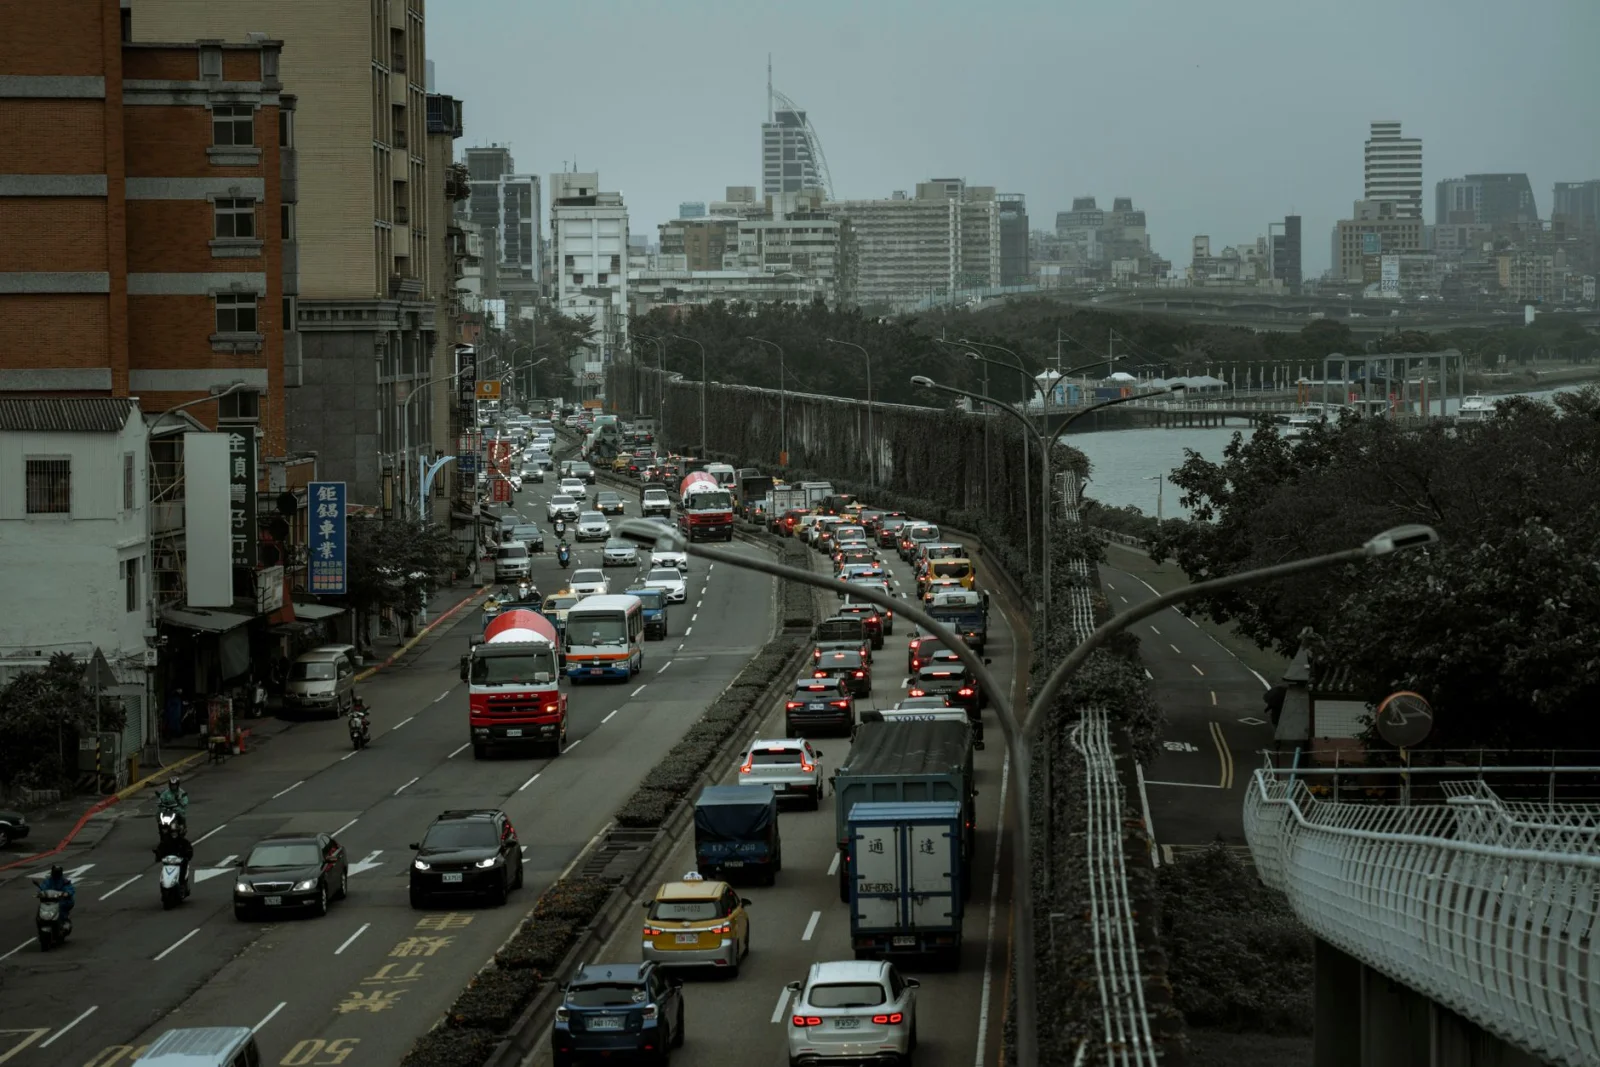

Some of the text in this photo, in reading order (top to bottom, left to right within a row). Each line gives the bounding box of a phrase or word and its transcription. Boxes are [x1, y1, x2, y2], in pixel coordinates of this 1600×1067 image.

[895, 714, 935, 723] VOLVO
[868, 838, 935, 855] 通 達
[859, 883, 894, 893] AXF-8763
[279, 1038, 361, 1066] 50
